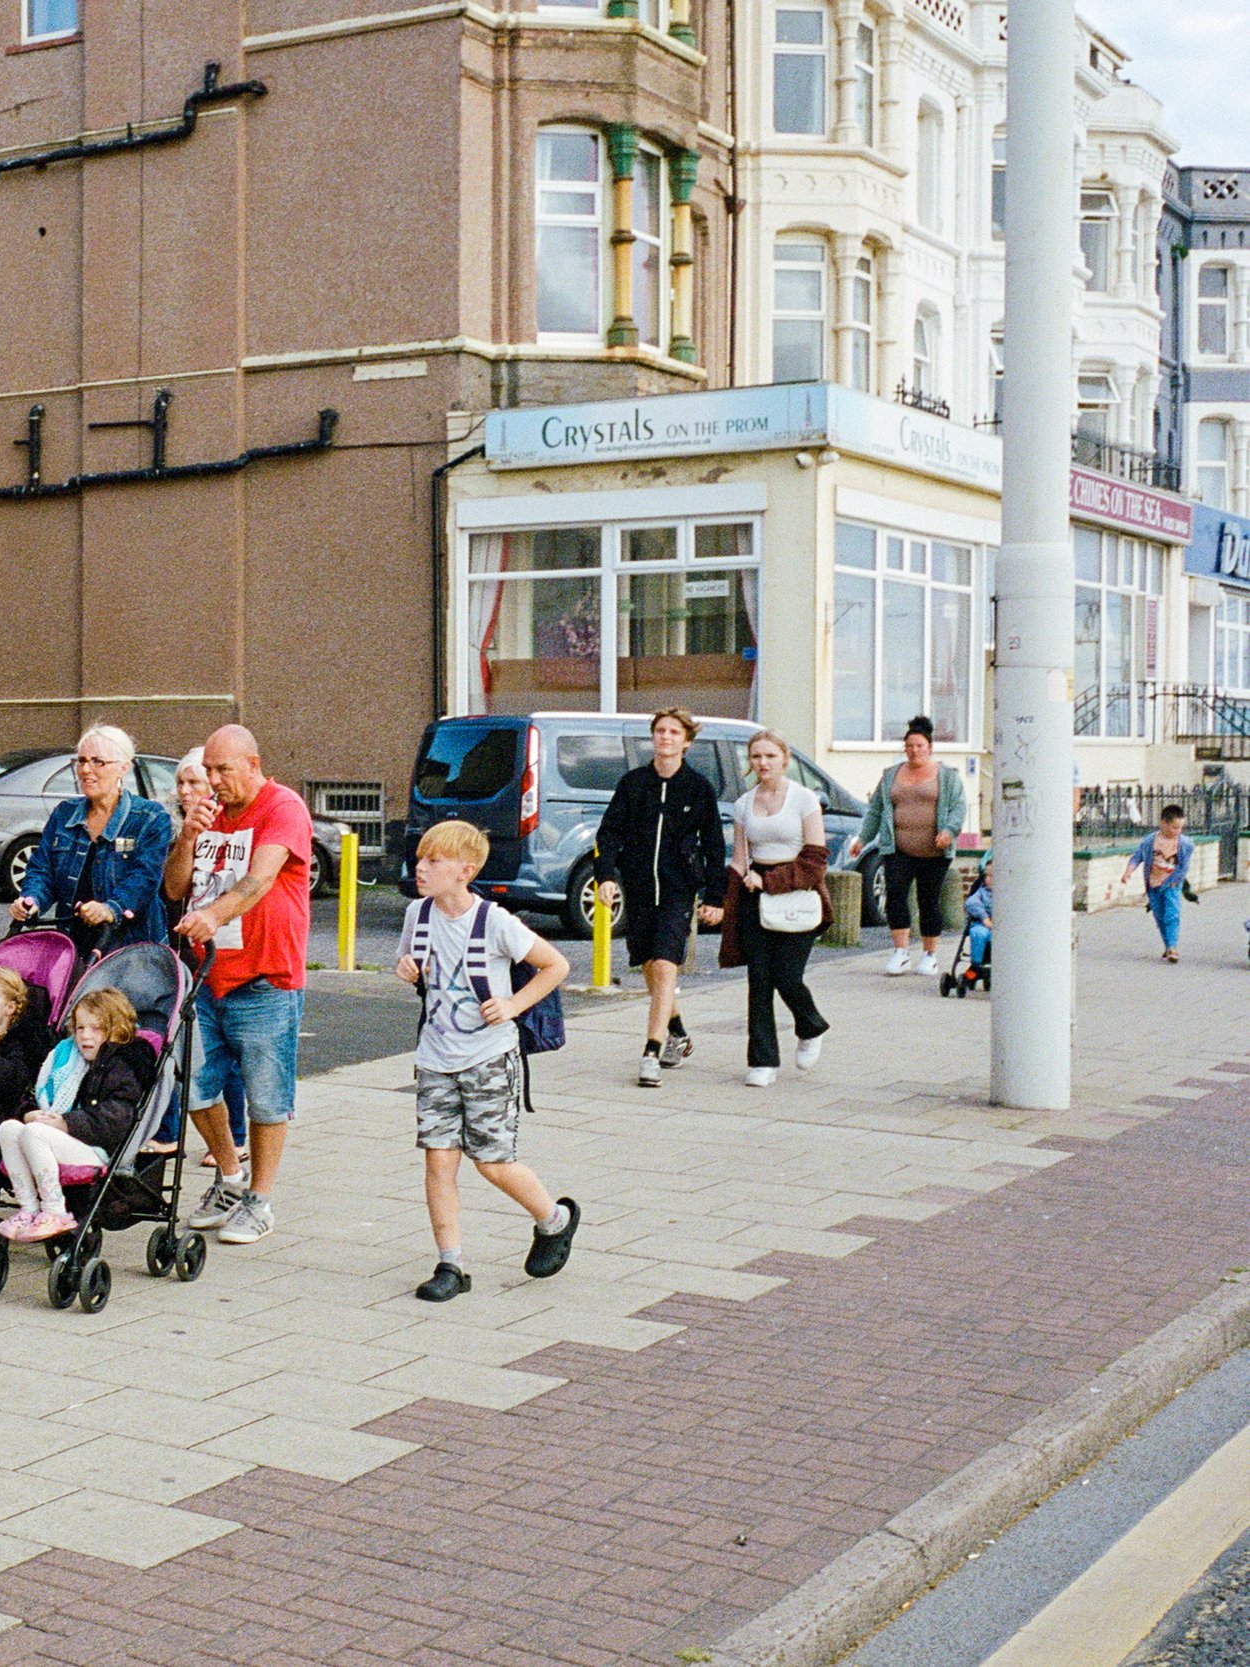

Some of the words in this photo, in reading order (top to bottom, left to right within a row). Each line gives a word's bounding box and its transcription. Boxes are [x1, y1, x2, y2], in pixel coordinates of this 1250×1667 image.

[666, 422, 688, 439] ON
[694, 420, 720, 436] THE
[725, 416, 769, 434] PROM
[1074, 476, 1110, 512] CHIMES
[1111, 487, 1124, 515] ON
[1126, 491, 1143, 521] THE
[1144, 497, 1162, 526] SEA
